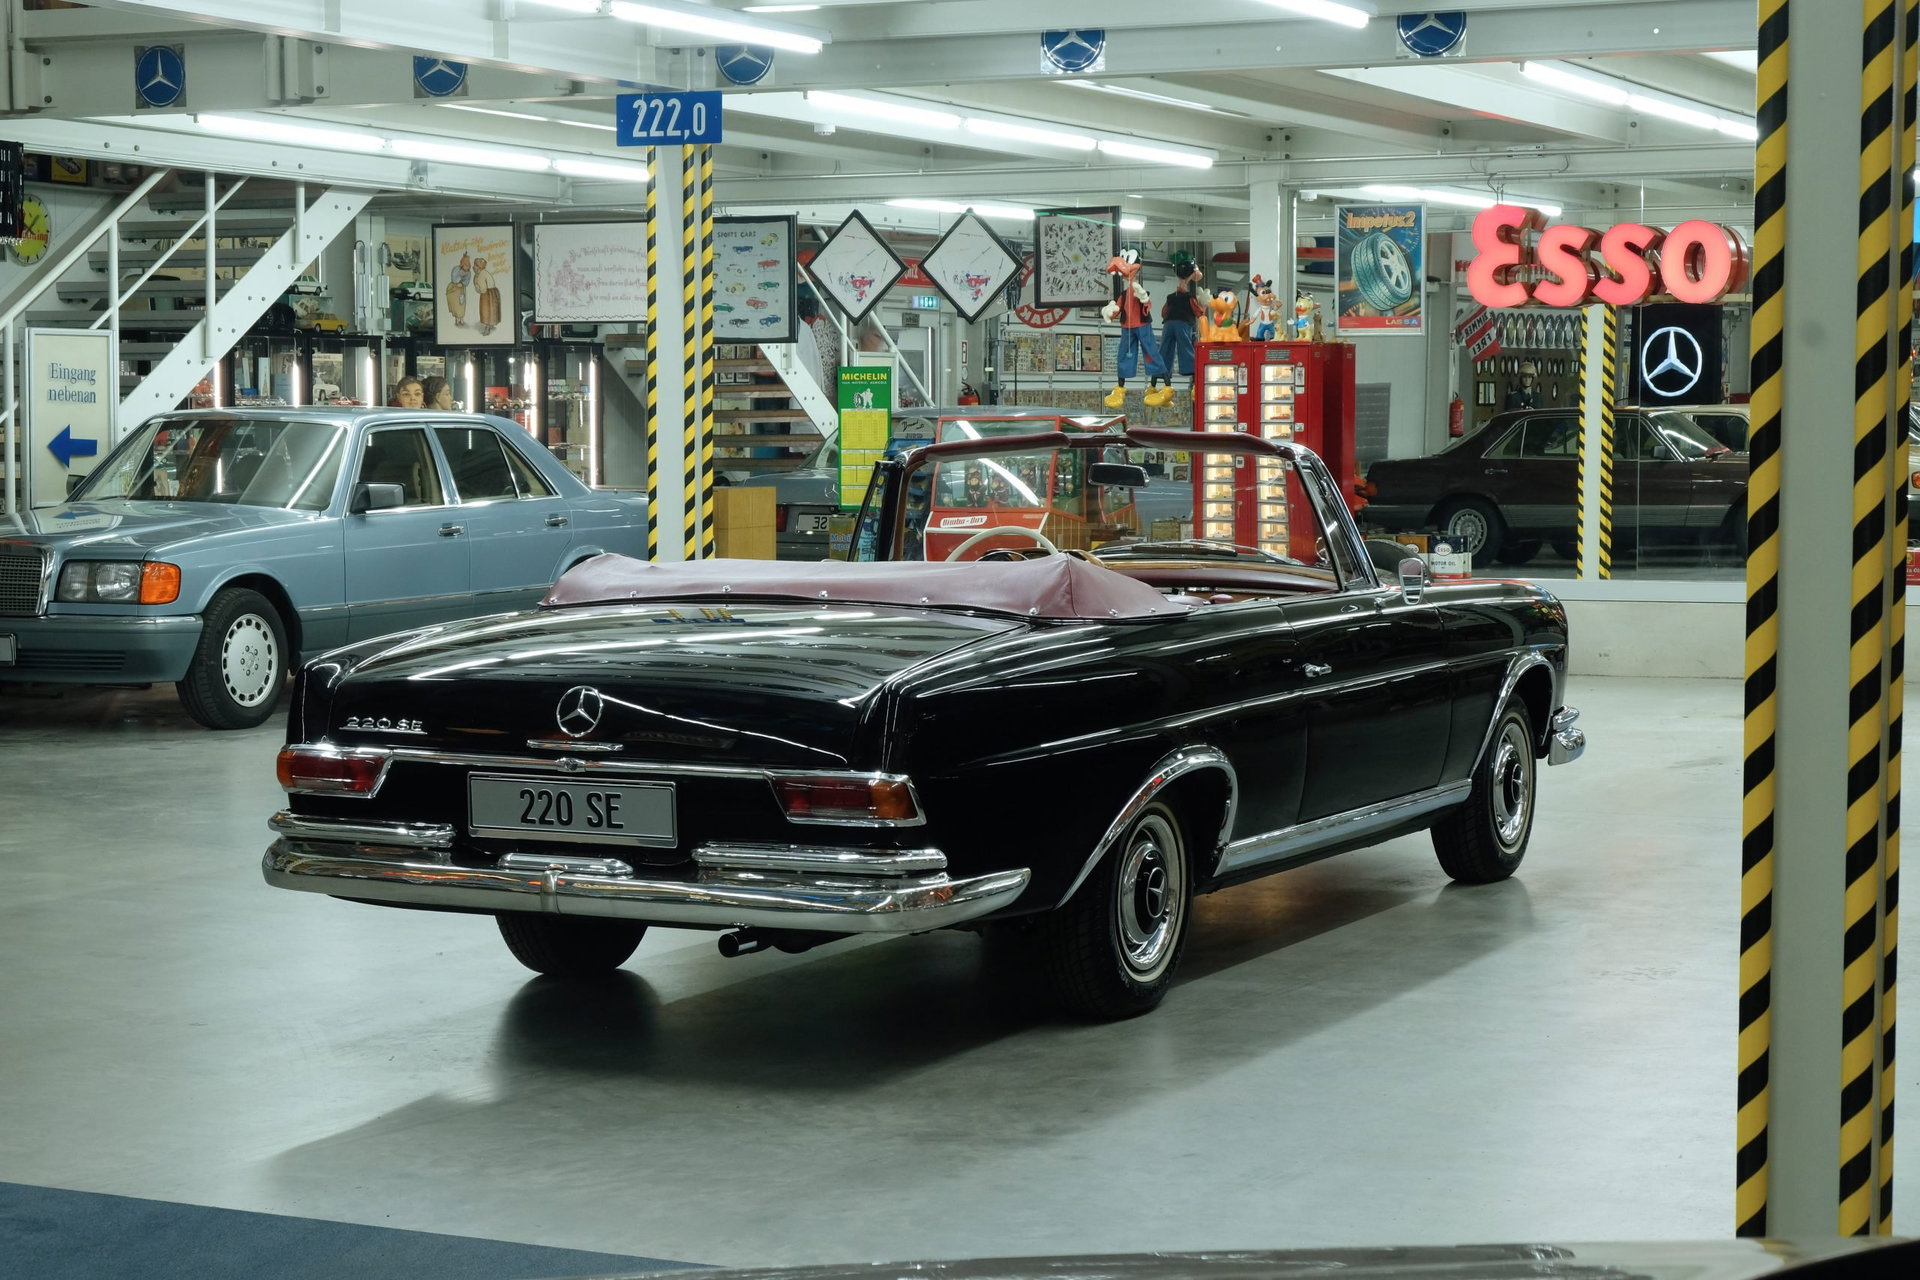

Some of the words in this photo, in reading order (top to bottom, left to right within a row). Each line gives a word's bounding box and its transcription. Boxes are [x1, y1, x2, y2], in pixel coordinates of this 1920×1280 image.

[633, 98, 706, 140] 222,0
[50, 362, 97, 386] Eingang
[841, 372, 888, 381] MICHELIN
[48, 385, 97, 404] nebenan
[346, 716, 392, 730] 220
[396, 718, 424, 732] SE
[519, 787, 574, 827] 220
[586, 791, 625, 830] SE
